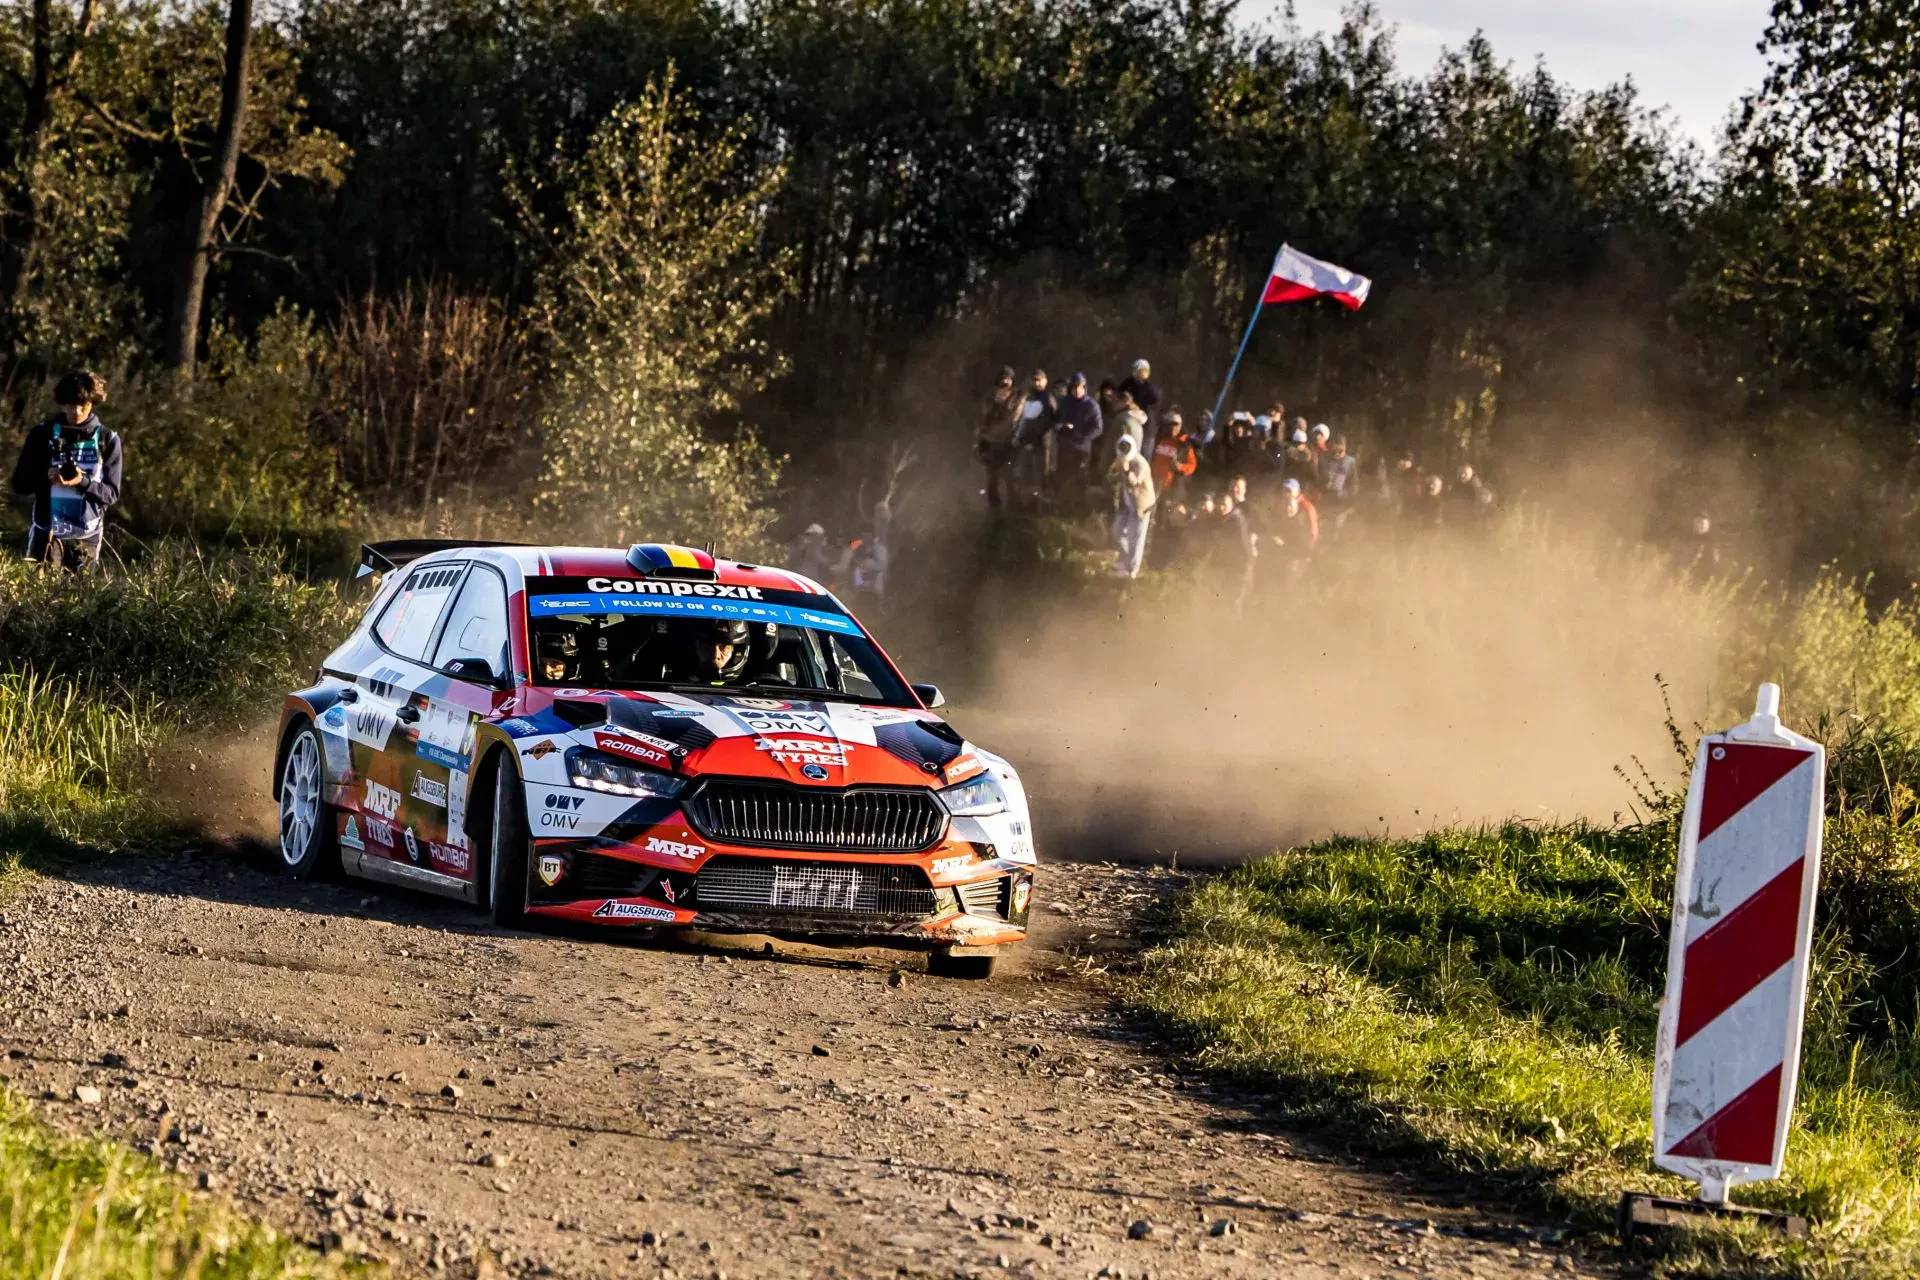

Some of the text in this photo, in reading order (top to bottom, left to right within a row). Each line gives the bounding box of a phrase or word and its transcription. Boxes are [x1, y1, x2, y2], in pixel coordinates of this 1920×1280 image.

[587, 577, 764, 601] Compexit
[612, 599, 663, 608] FOLLOW
[357, 704, 387, 740] OMV
[748, 720, 829, 732] OMV
[600, 739, 666, 762] ROMBAT
[754, 738, 855, 754] MRF
[770, 752, 849, 766] TYRES
[421, 778, 446, 800] AUGSBURG
[364, 778, 401, 820] MRF
[541, 812, 580, 829] OMV
[429, 841, 470, 871] ROMBAT
[645, 837, 705, 859] MRF
[544, 862, 558, 873] BT
[616, 904, 675, 919] AUGSBURG
